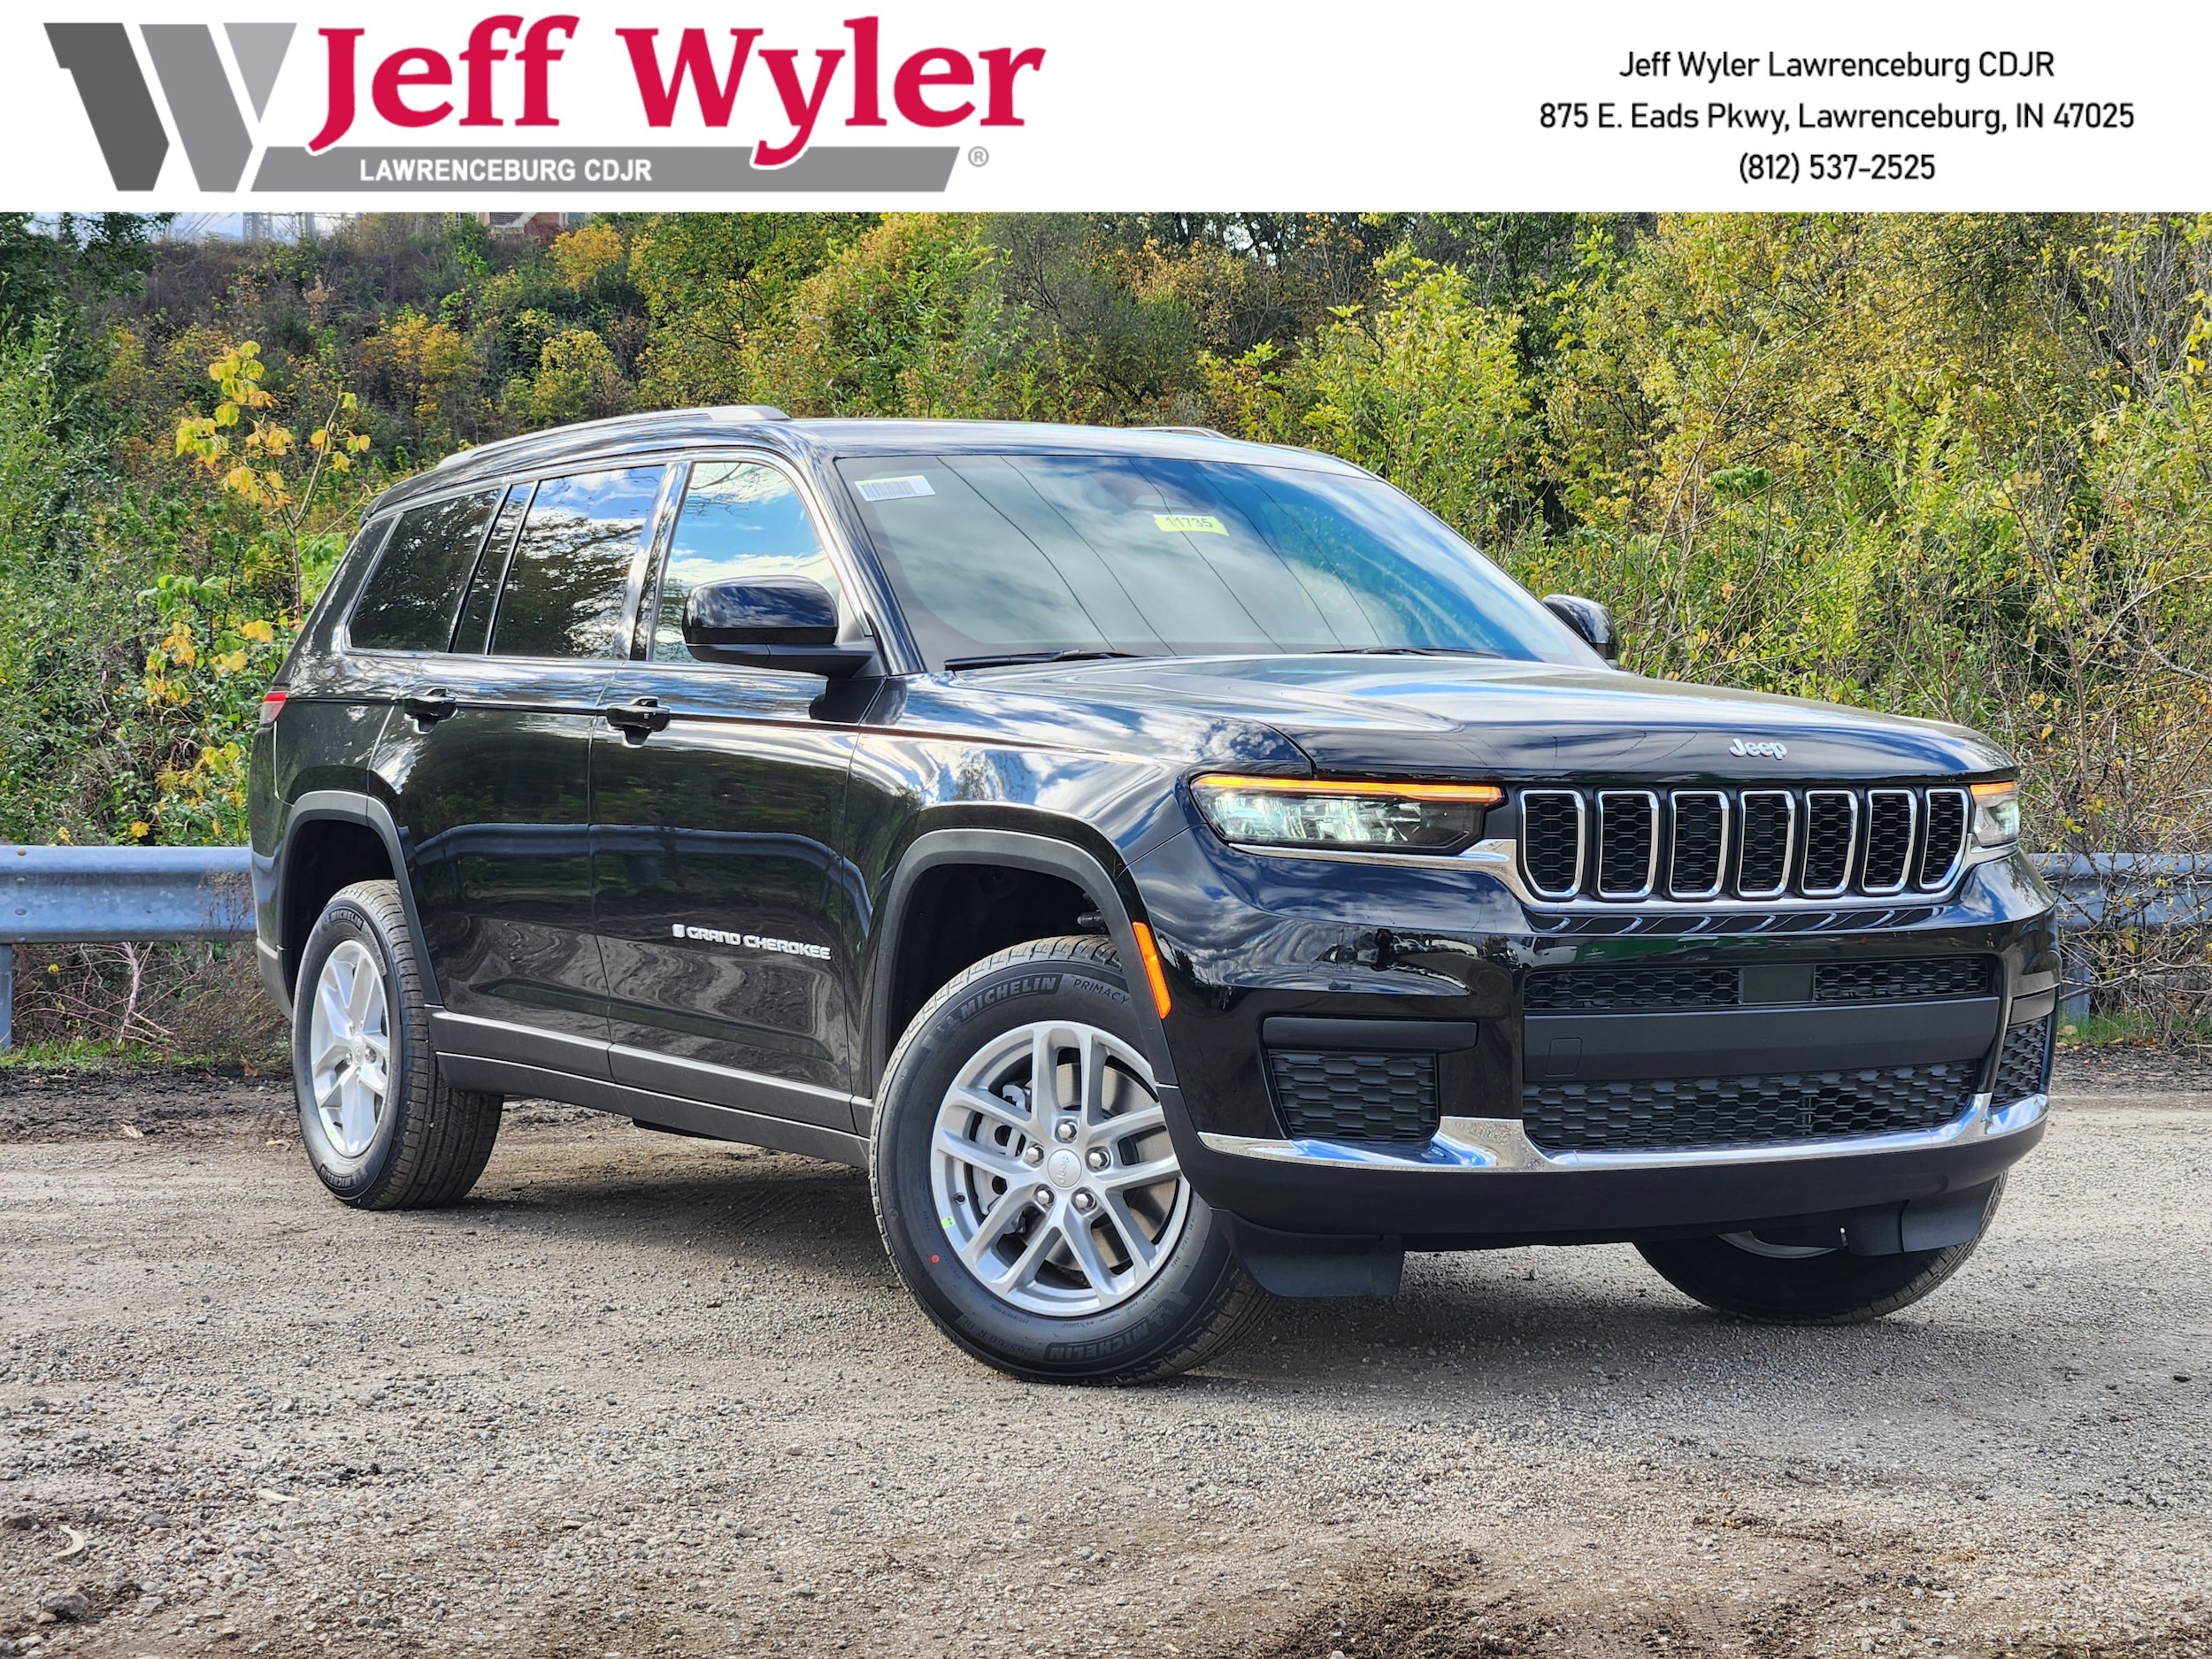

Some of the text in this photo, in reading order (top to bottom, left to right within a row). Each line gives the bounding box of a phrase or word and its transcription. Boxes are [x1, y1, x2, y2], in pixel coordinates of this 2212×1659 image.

[1166, 516, 1213, 528] 11735
[1729, 738, 1787, 761] Jeep
[686, 926, 832, 960] GRAND CHEROKEE
[960, 976, 1131, 1019] MICHELIN PRIMACY
[1050, 1321, 1150, 1361] MICHELIN
